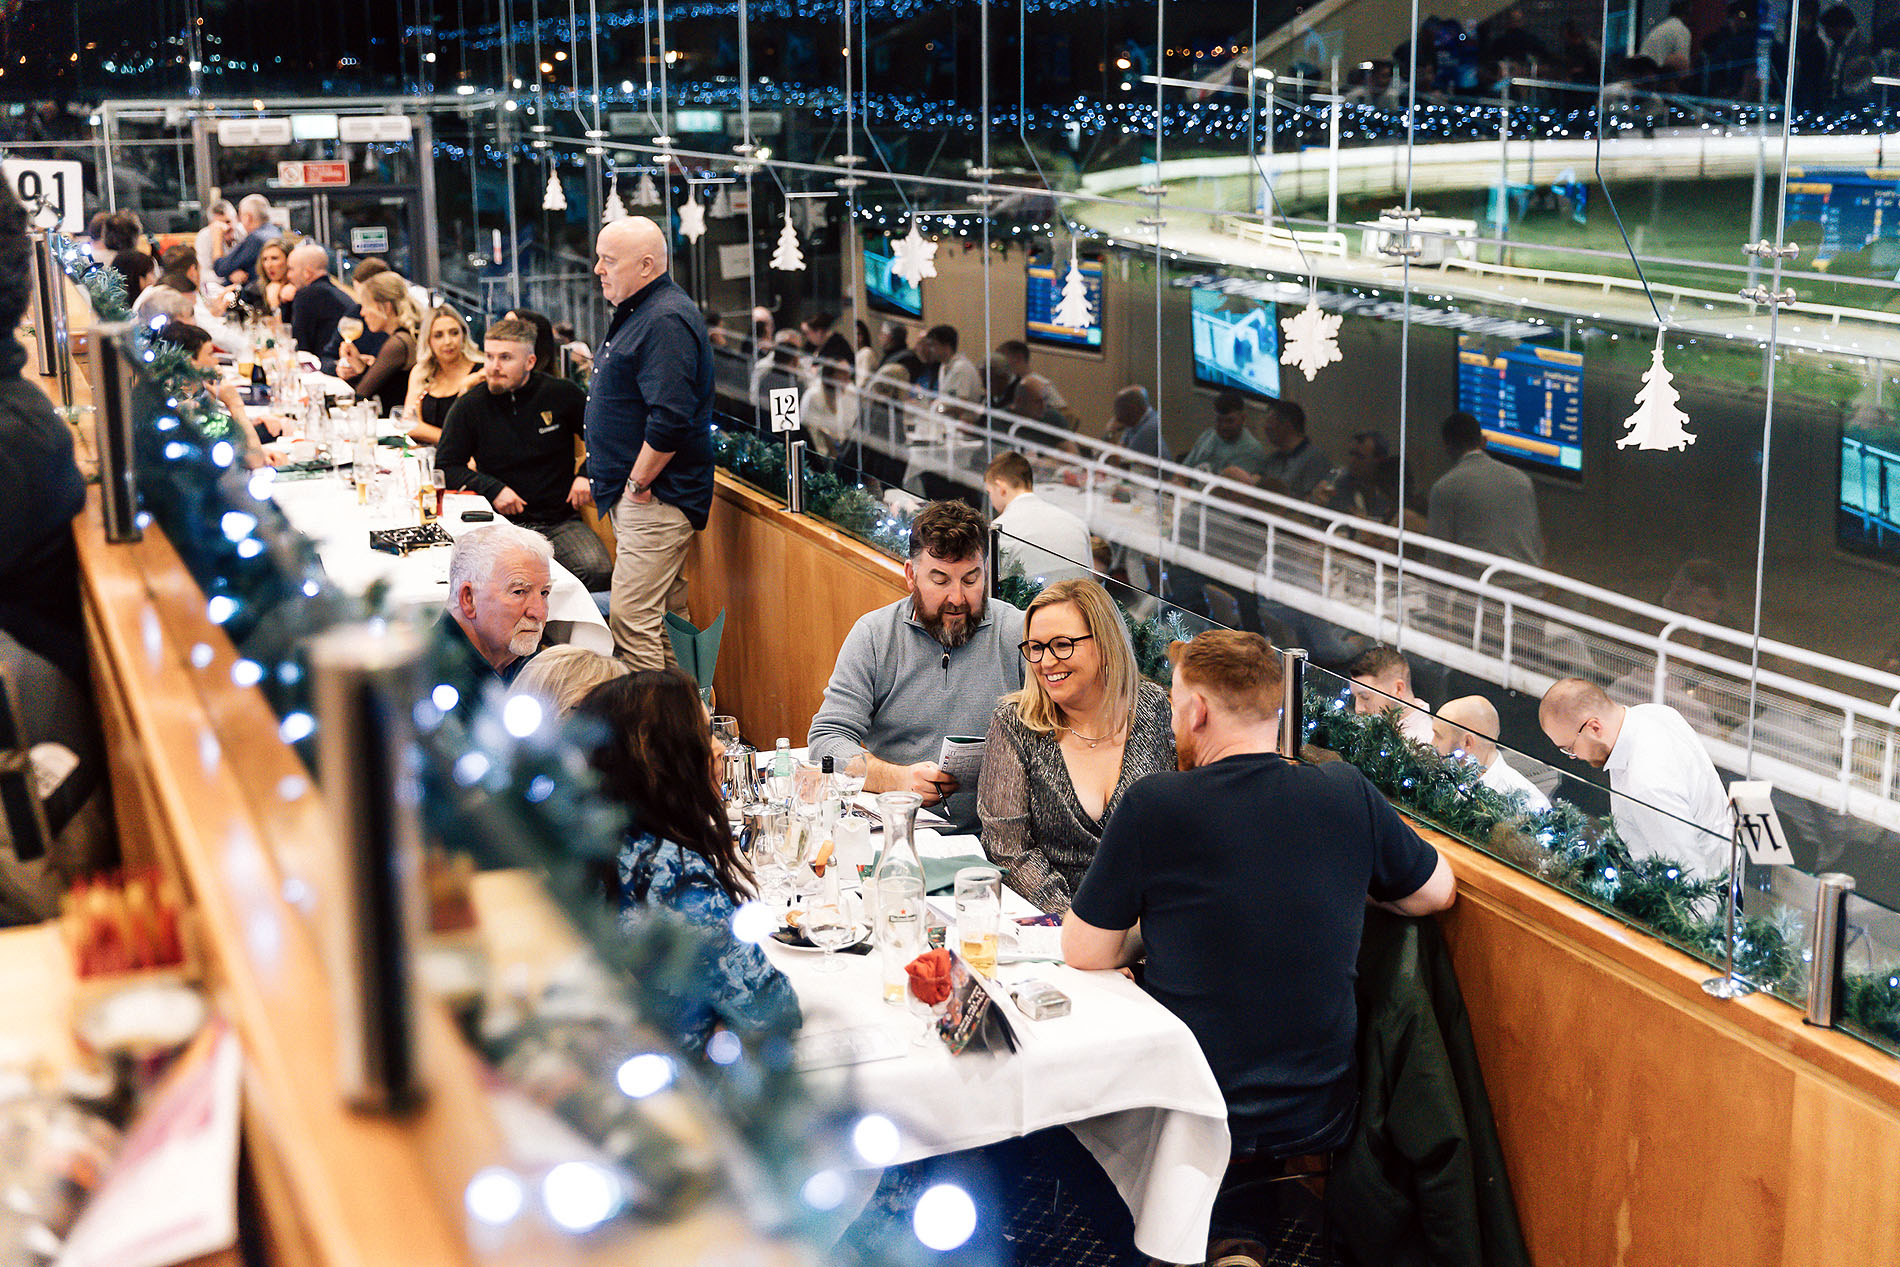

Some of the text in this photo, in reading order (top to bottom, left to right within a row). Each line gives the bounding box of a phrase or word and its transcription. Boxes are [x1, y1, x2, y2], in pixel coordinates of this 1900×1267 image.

[18, 170, 65, 219] 91
[774, 395, 796, 416] 12
[1741, 814, 1782, 852] 14
